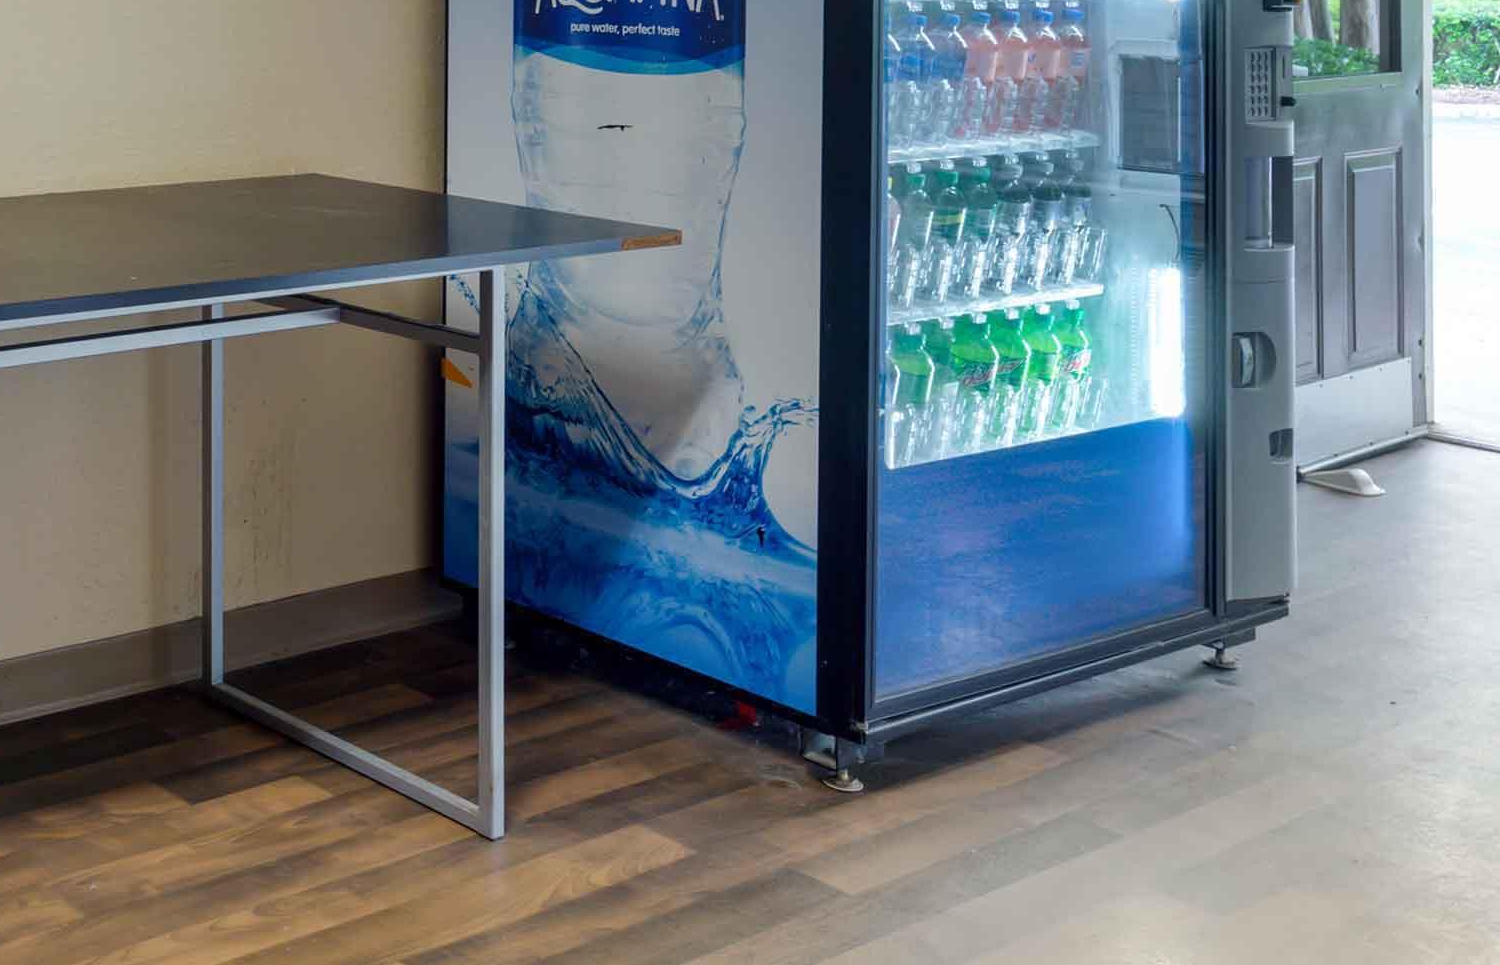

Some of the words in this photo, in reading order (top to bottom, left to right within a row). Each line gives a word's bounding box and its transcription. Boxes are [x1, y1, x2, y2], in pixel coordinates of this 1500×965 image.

[570, 23, 590, 35] pure
[591, 23, 620, 35] water,
[621, 22, 656, 36] perfect
[657, 25, 681, 37] taste
